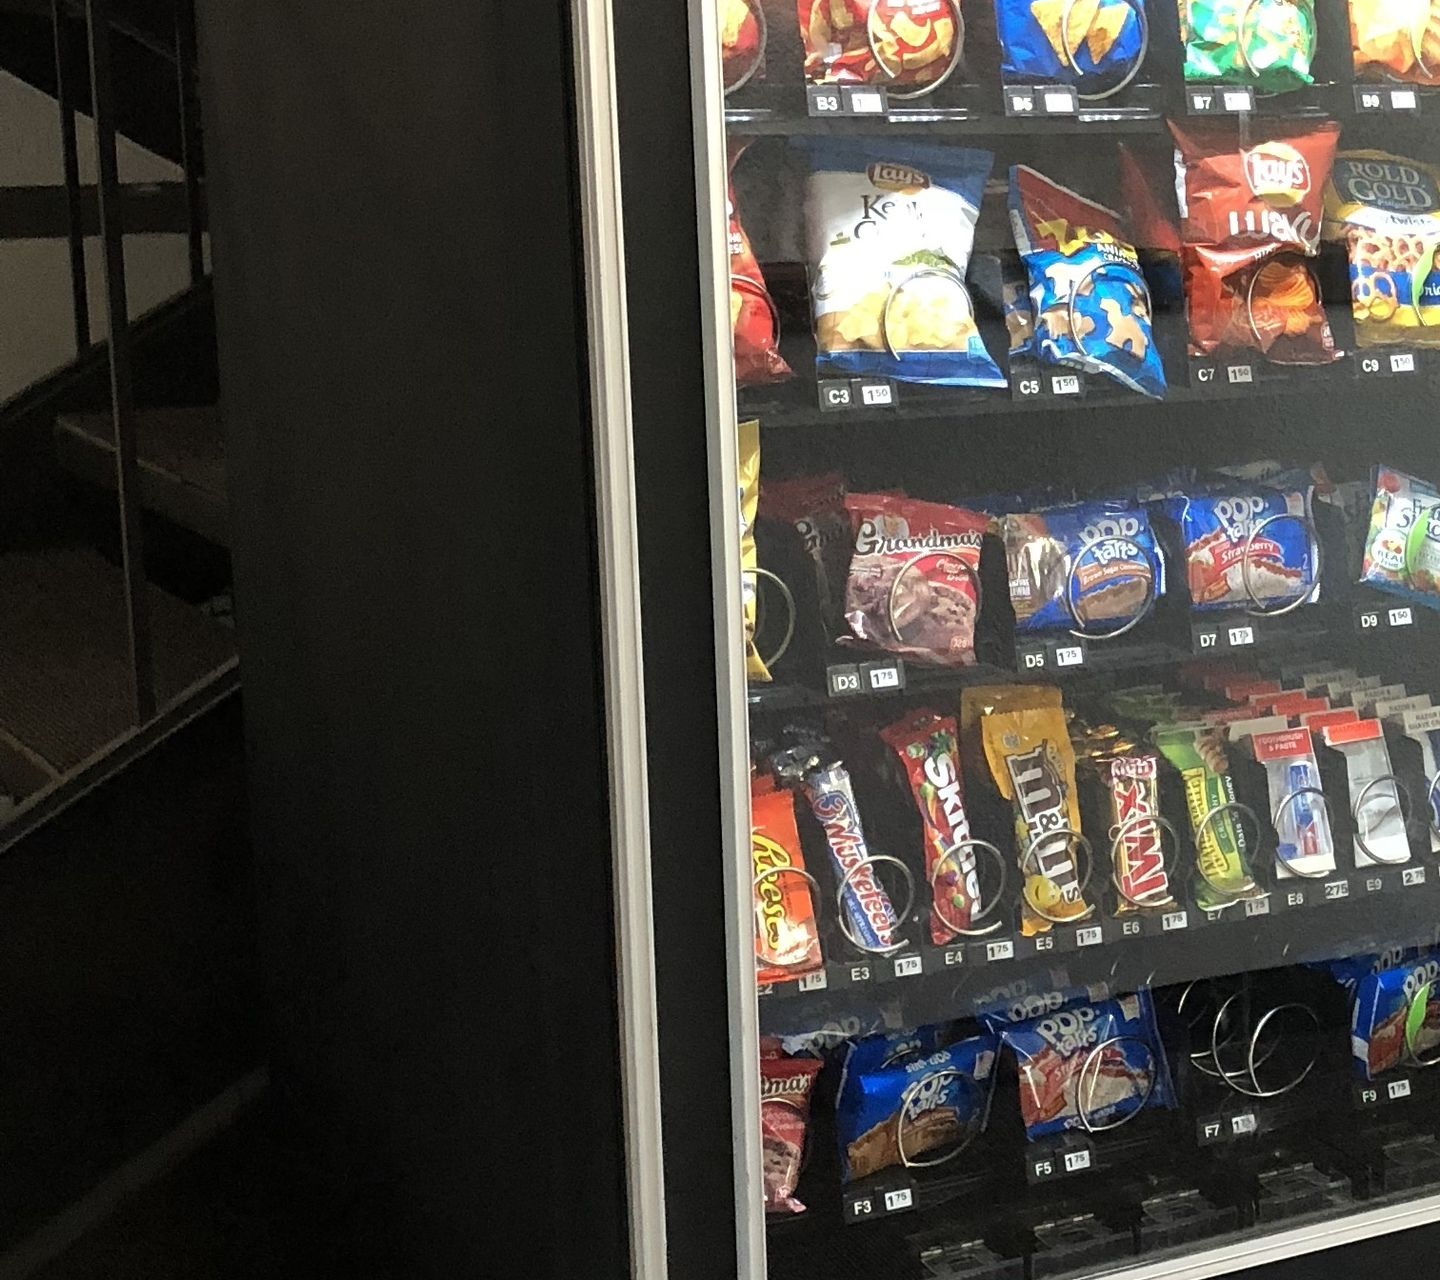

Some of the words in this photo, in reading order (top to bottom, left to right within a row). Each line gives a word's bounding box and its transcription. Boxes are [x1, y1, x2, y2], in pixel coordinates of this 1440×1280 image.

[816, 96, 838, 111] B3
[1012, 96, 1033, 111] B5
[1348, 161, 1420, 185] ROLD
[1348, 178, 1432, 208] GOLD
[1362, 359, 1379, 372] C9
[1198, 368, 1215, 382] C7
[1020, 380, 1039, 394] C5
[828, 388, 850, 403] C3
[855, 519, 983, 555] Grandma's
[1361, 614, 1378, 628] D9
[1200, 633, 1217, 648] D7
[1025, 654, 1044, 668] D5
[837, 675, 858, 690] D3
[1258, 732, 1304, 745] TOOTHBRUSH
[1275, 742, 1297, 751] PASTE
[1367, 878, 1383, 891] E9
[1288, 892, 1304, 906] E8
[1123, 921, 1140, 935] E6
[1035, 937, 1053, 950] E5
[945, 951, 963, 965] E4
[851, 968, 869, 980] E3
[1362, 1090, 1377, 1103] F9
[1205, 1124, 1221, 1138] F7
[1035, 1162, 1052, 1176] F5
[854, 1200, 872, 1215] F3
